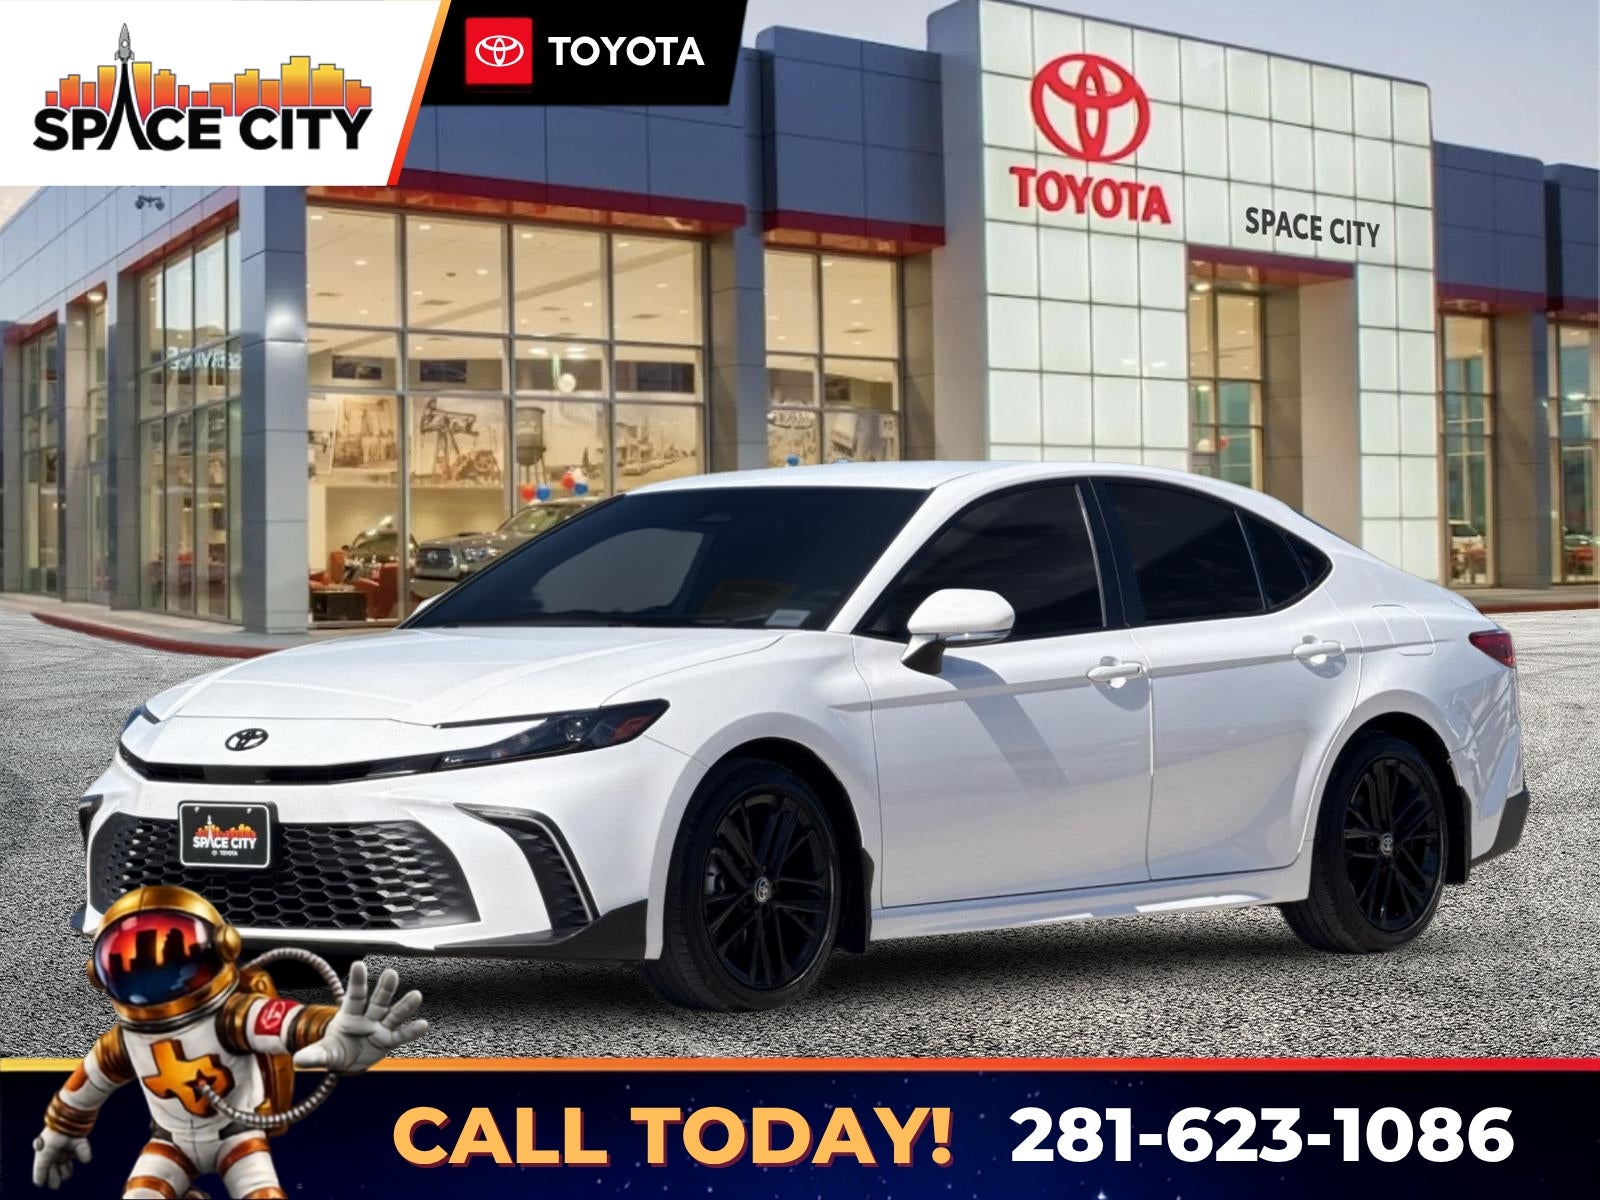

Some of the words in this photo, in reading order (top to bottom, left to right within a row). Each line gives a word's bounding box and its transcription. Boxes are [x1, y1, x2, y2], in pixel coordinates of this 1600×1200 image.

[1009, 166, 1171, 224] TOYOTA
[1245, 206, 1323, 242] SPACE
[1329, 217, 1381, 248] CITY
[193, 836, 228, 849] SPACE
[231, 837, 256, 849] CITY
